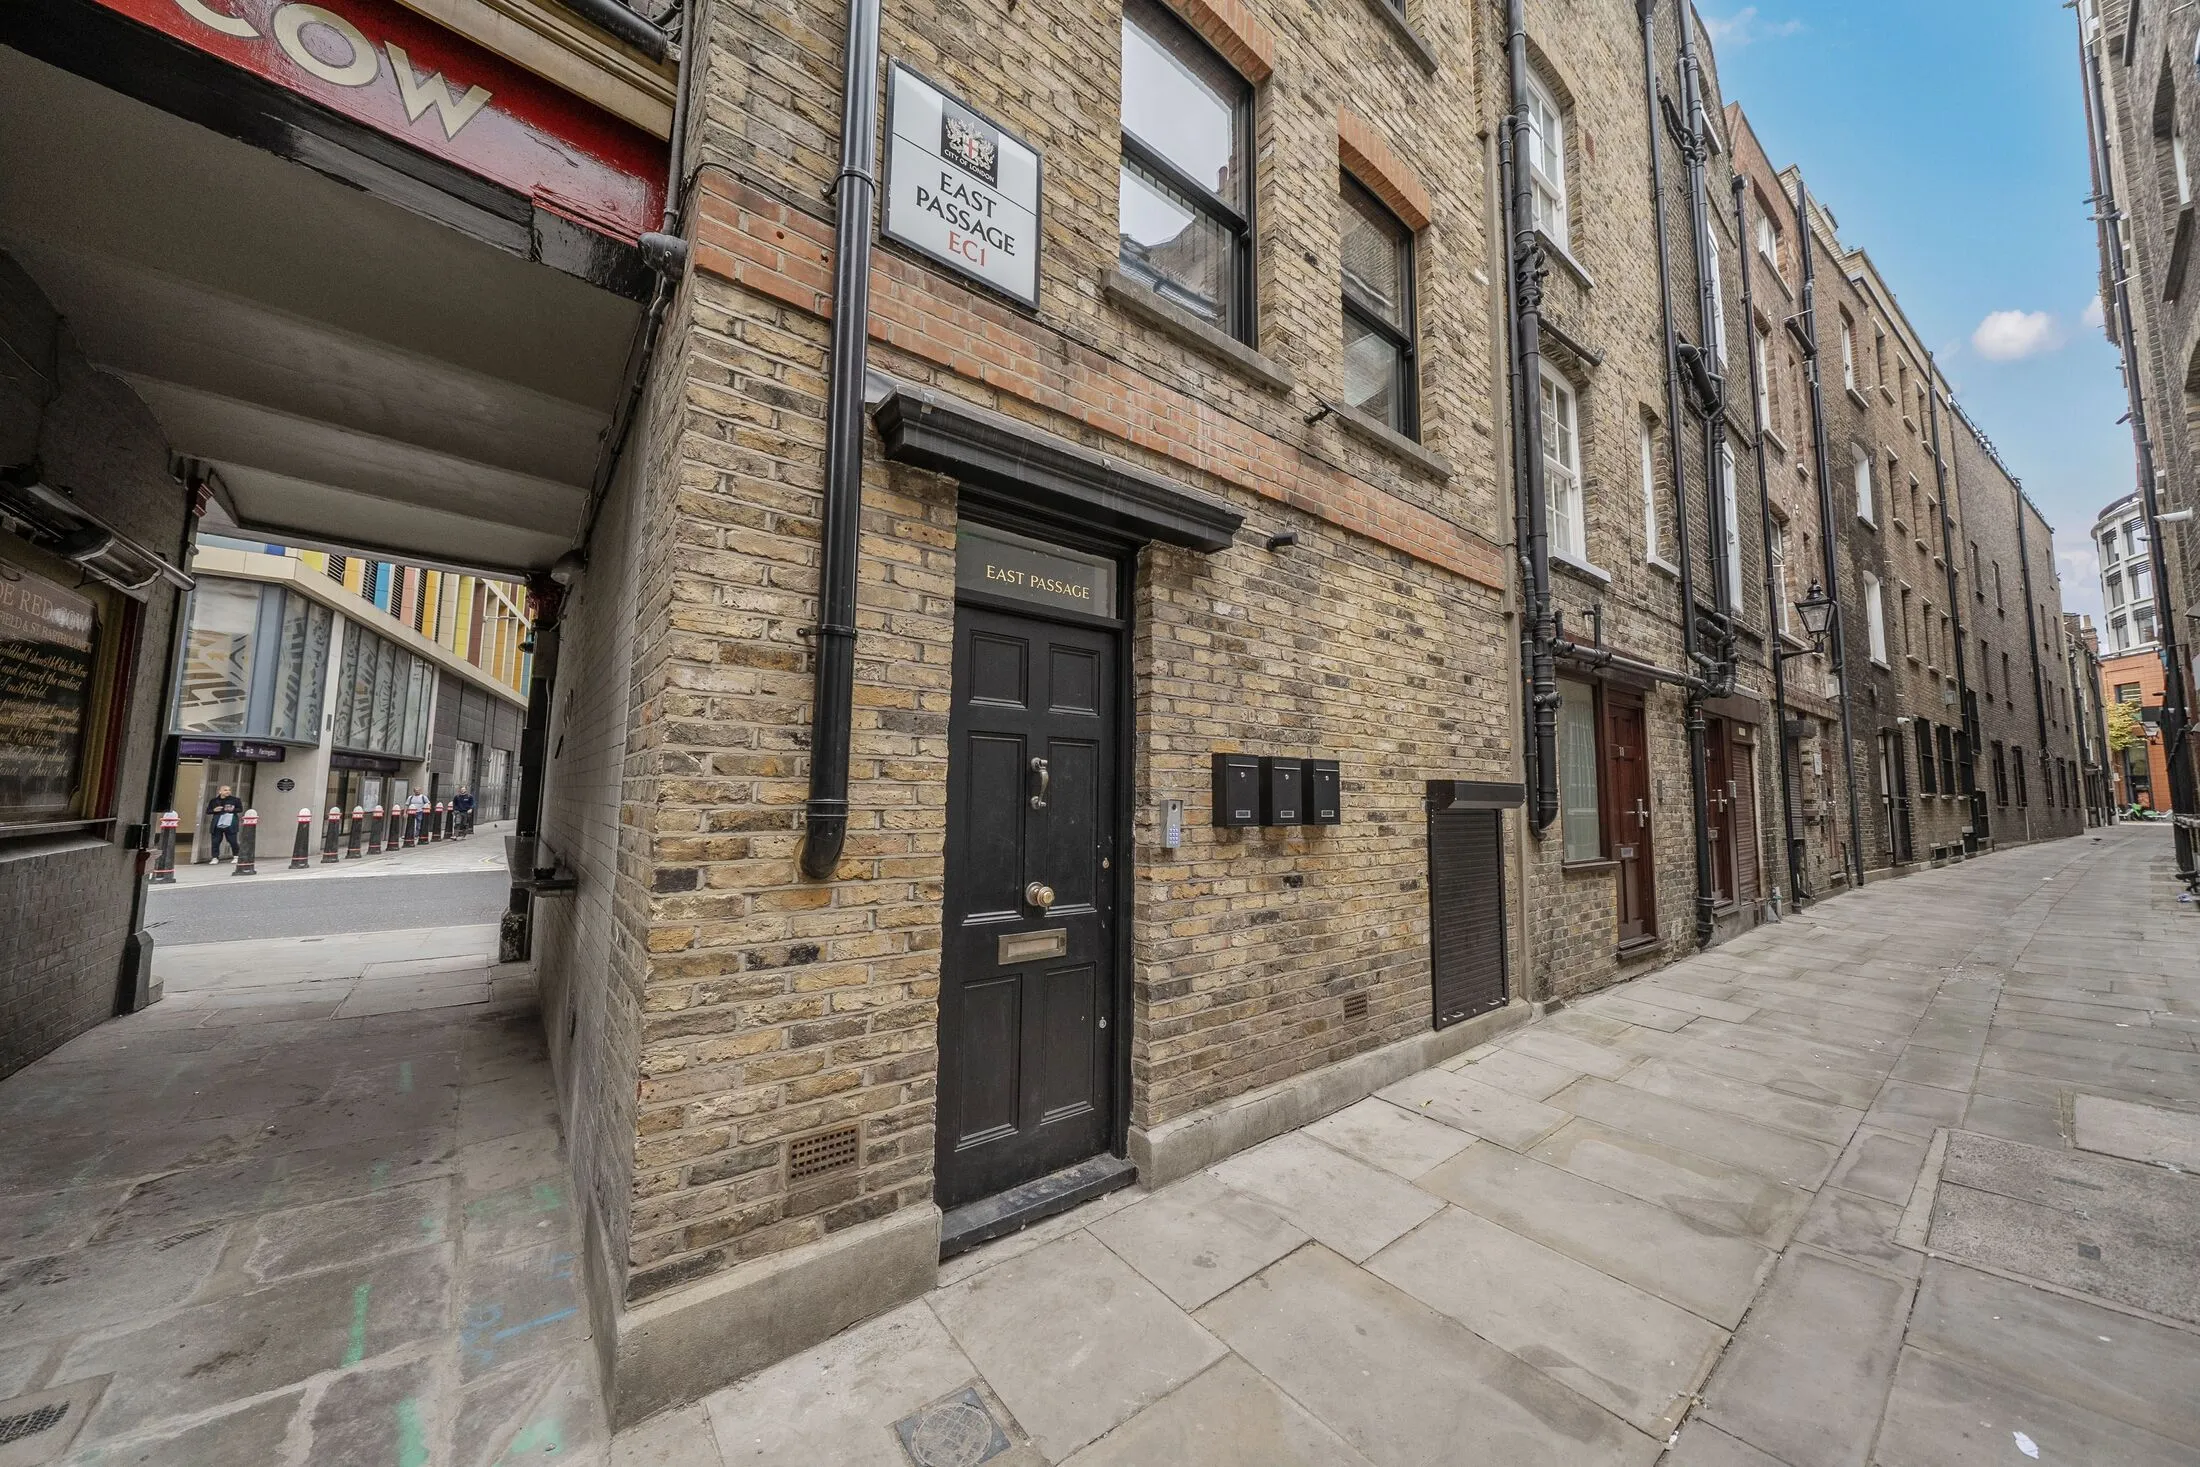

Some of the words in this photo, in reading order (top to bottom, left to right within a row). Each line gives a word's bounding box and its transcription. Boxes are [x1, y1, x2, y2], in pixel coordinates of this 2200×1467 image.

[944, 149, 959, 161] CITY
[960, 158, 968, 166] OF
[969, 163, 995, 183] LONDON
[940, 171, 997, 218] EAST
[915, 185, 1016, 256] PASSAGE
[948, 230, 986, 267] EC1
[986, 565, 1025, 585] EAST
[1030, 575, 1091, 600] PASSAGE
[19, 589, 54, 620] RED
